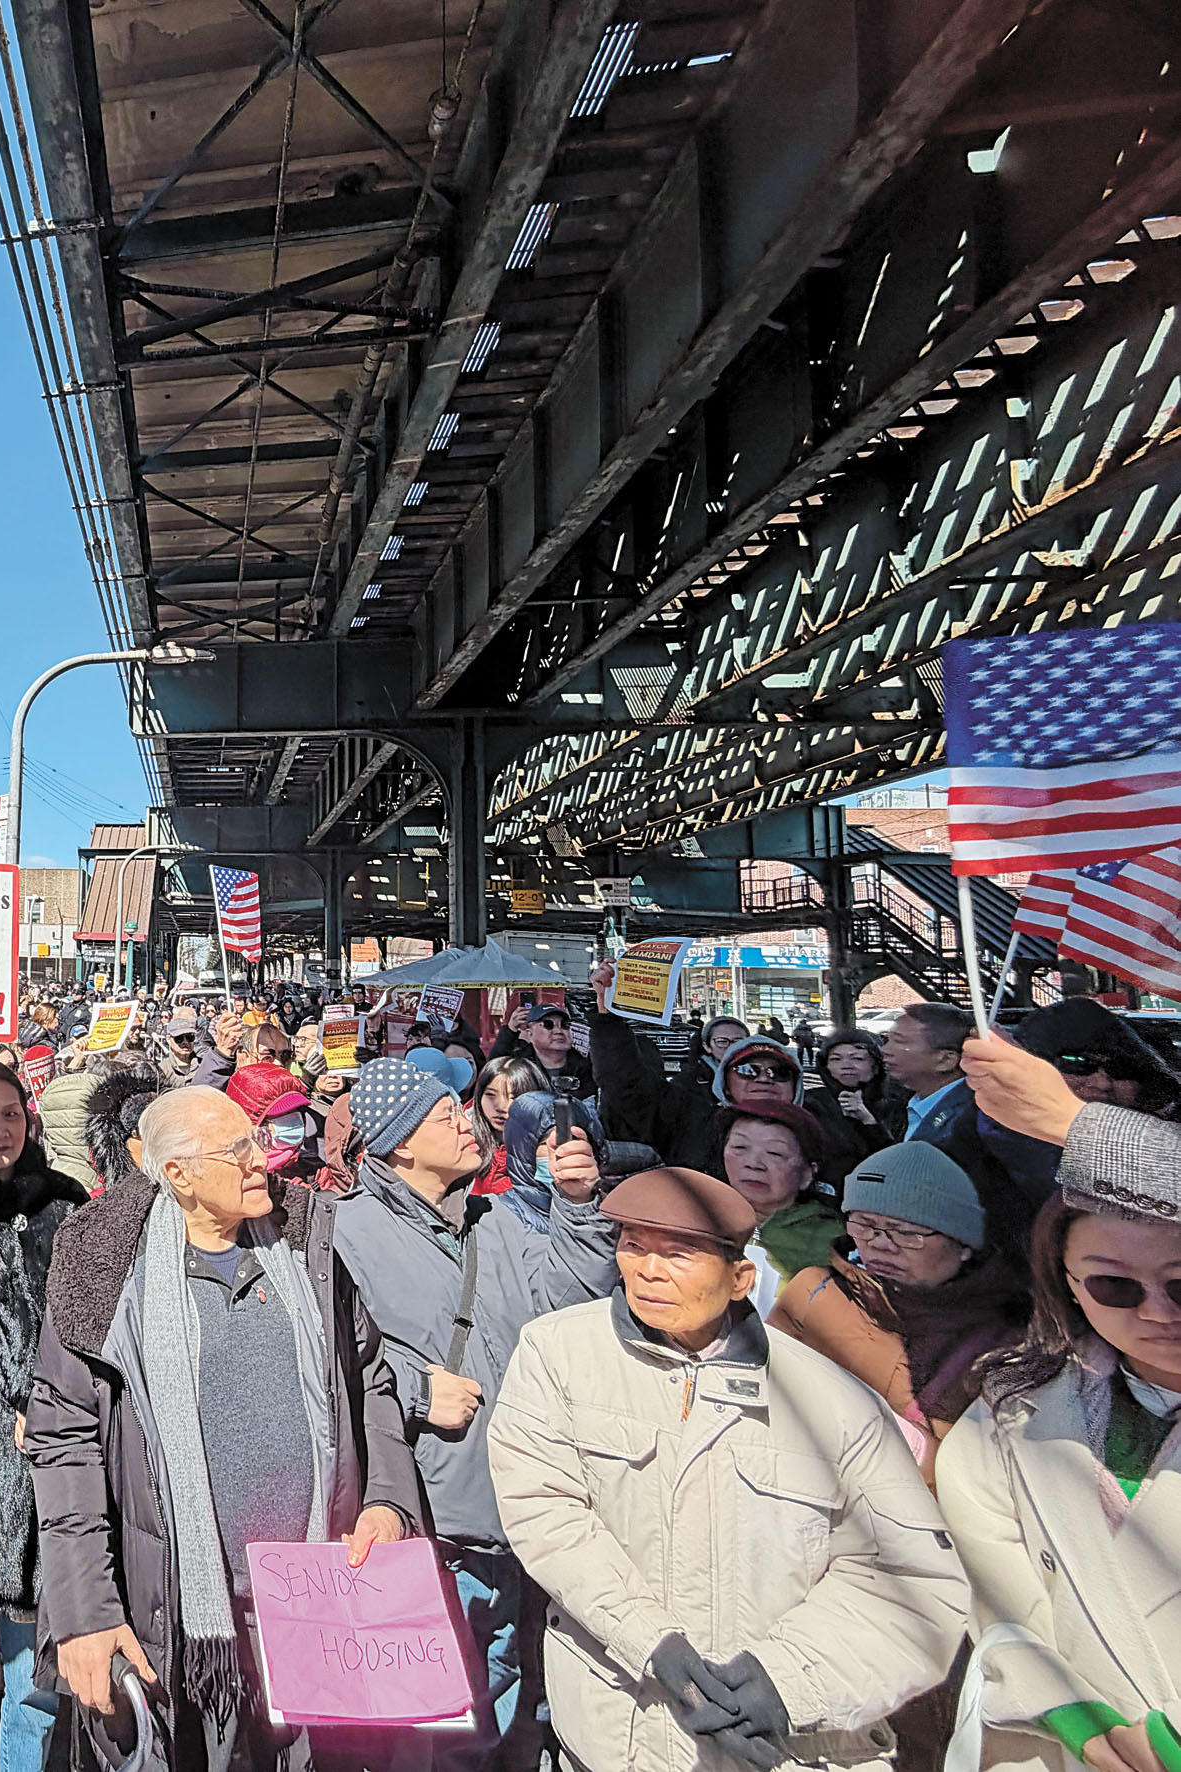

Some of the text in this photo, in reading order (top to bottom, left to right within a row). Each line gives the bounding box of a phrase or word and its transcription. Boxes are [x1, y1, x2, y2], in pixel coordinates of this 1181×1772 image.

[627, 950, 673, 961] MAMDANI
[259, 1553, 382, 1603] SENIOR
[319, 1628, 448, 1675] HOUSING
